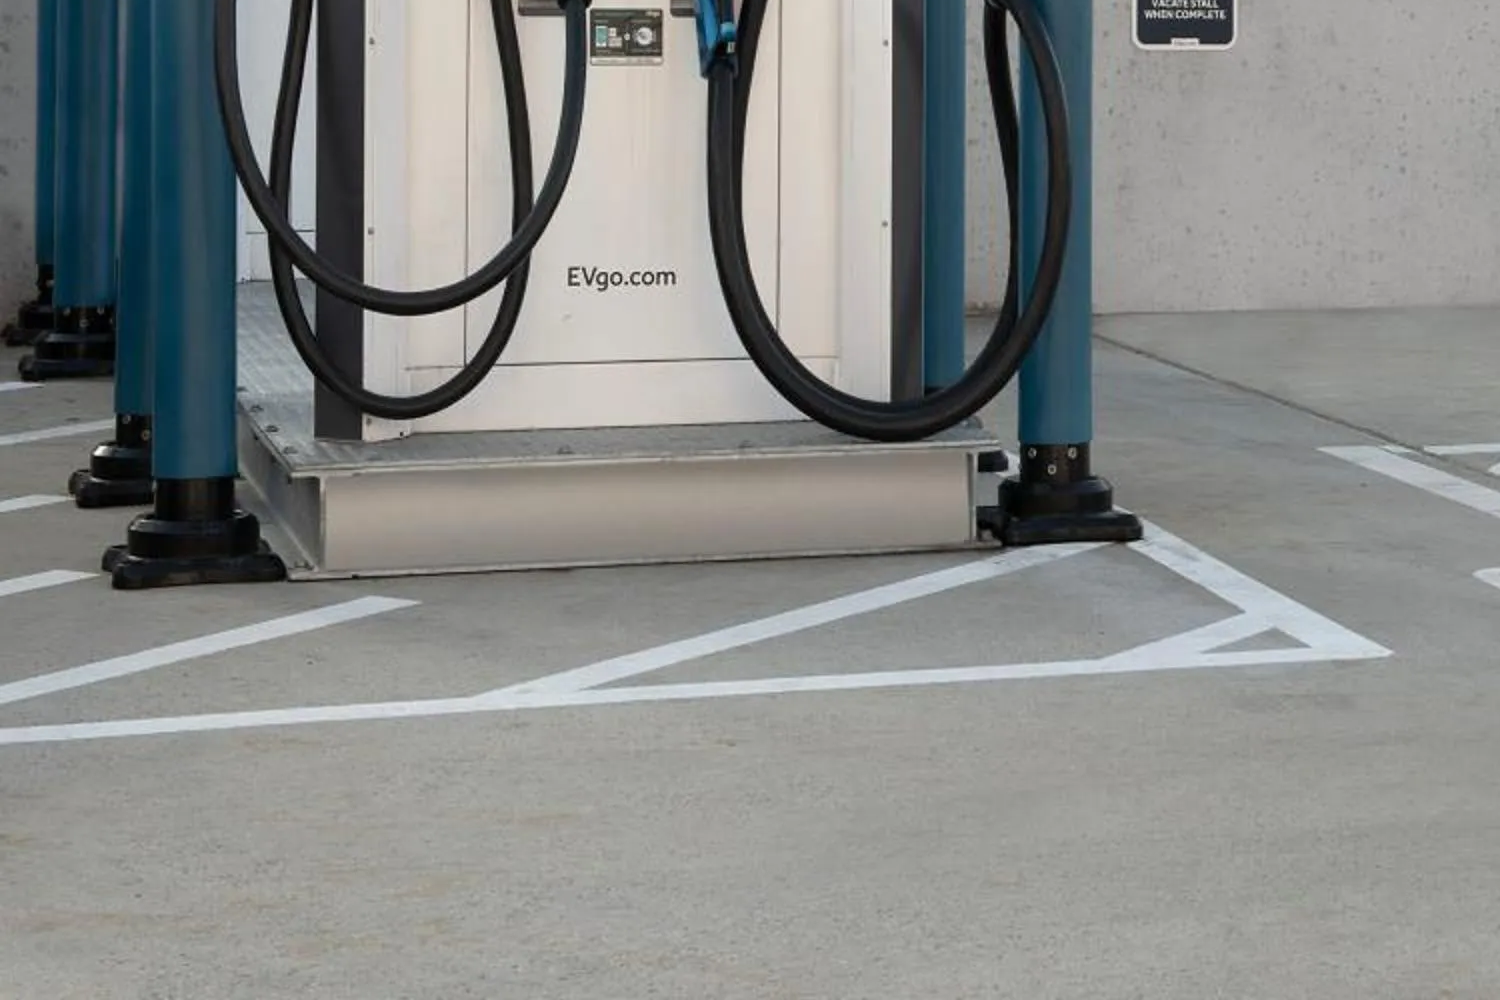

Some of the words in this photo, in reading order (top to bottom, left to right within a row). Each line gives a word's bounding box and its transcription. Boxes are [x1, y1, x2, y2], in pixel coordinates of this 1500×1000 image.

[1144, 9, 1173, 19] WHEN
[1175, 9, 1226, 19] COMPLETE
[567, 266, 677, 292] EVgo.com
